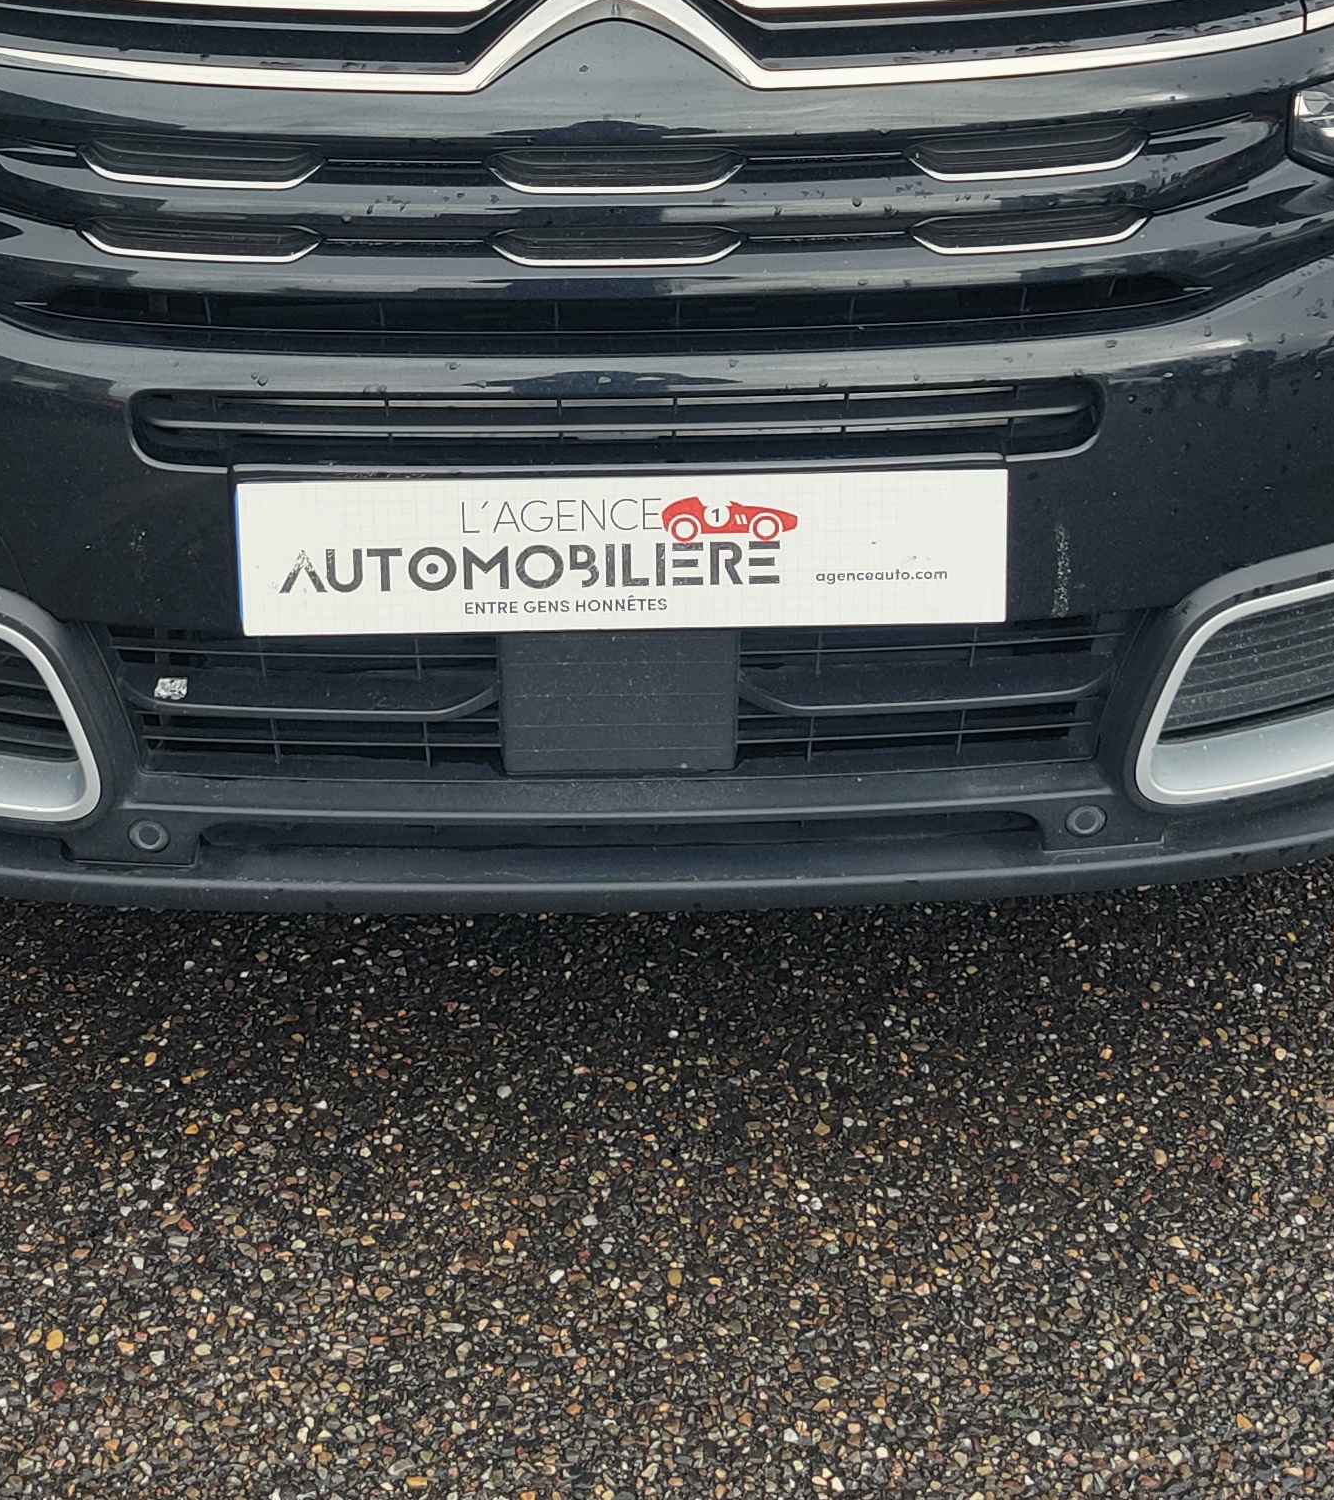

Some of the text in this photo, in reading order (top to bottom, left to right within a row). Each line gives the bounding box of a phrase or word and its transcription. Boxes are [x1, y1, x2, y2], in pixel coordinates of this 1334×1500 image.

[814, 567, 950, 585] agenceauto.com
[463, 593, 669, 615] ENTRE GENS HONNÊTES
